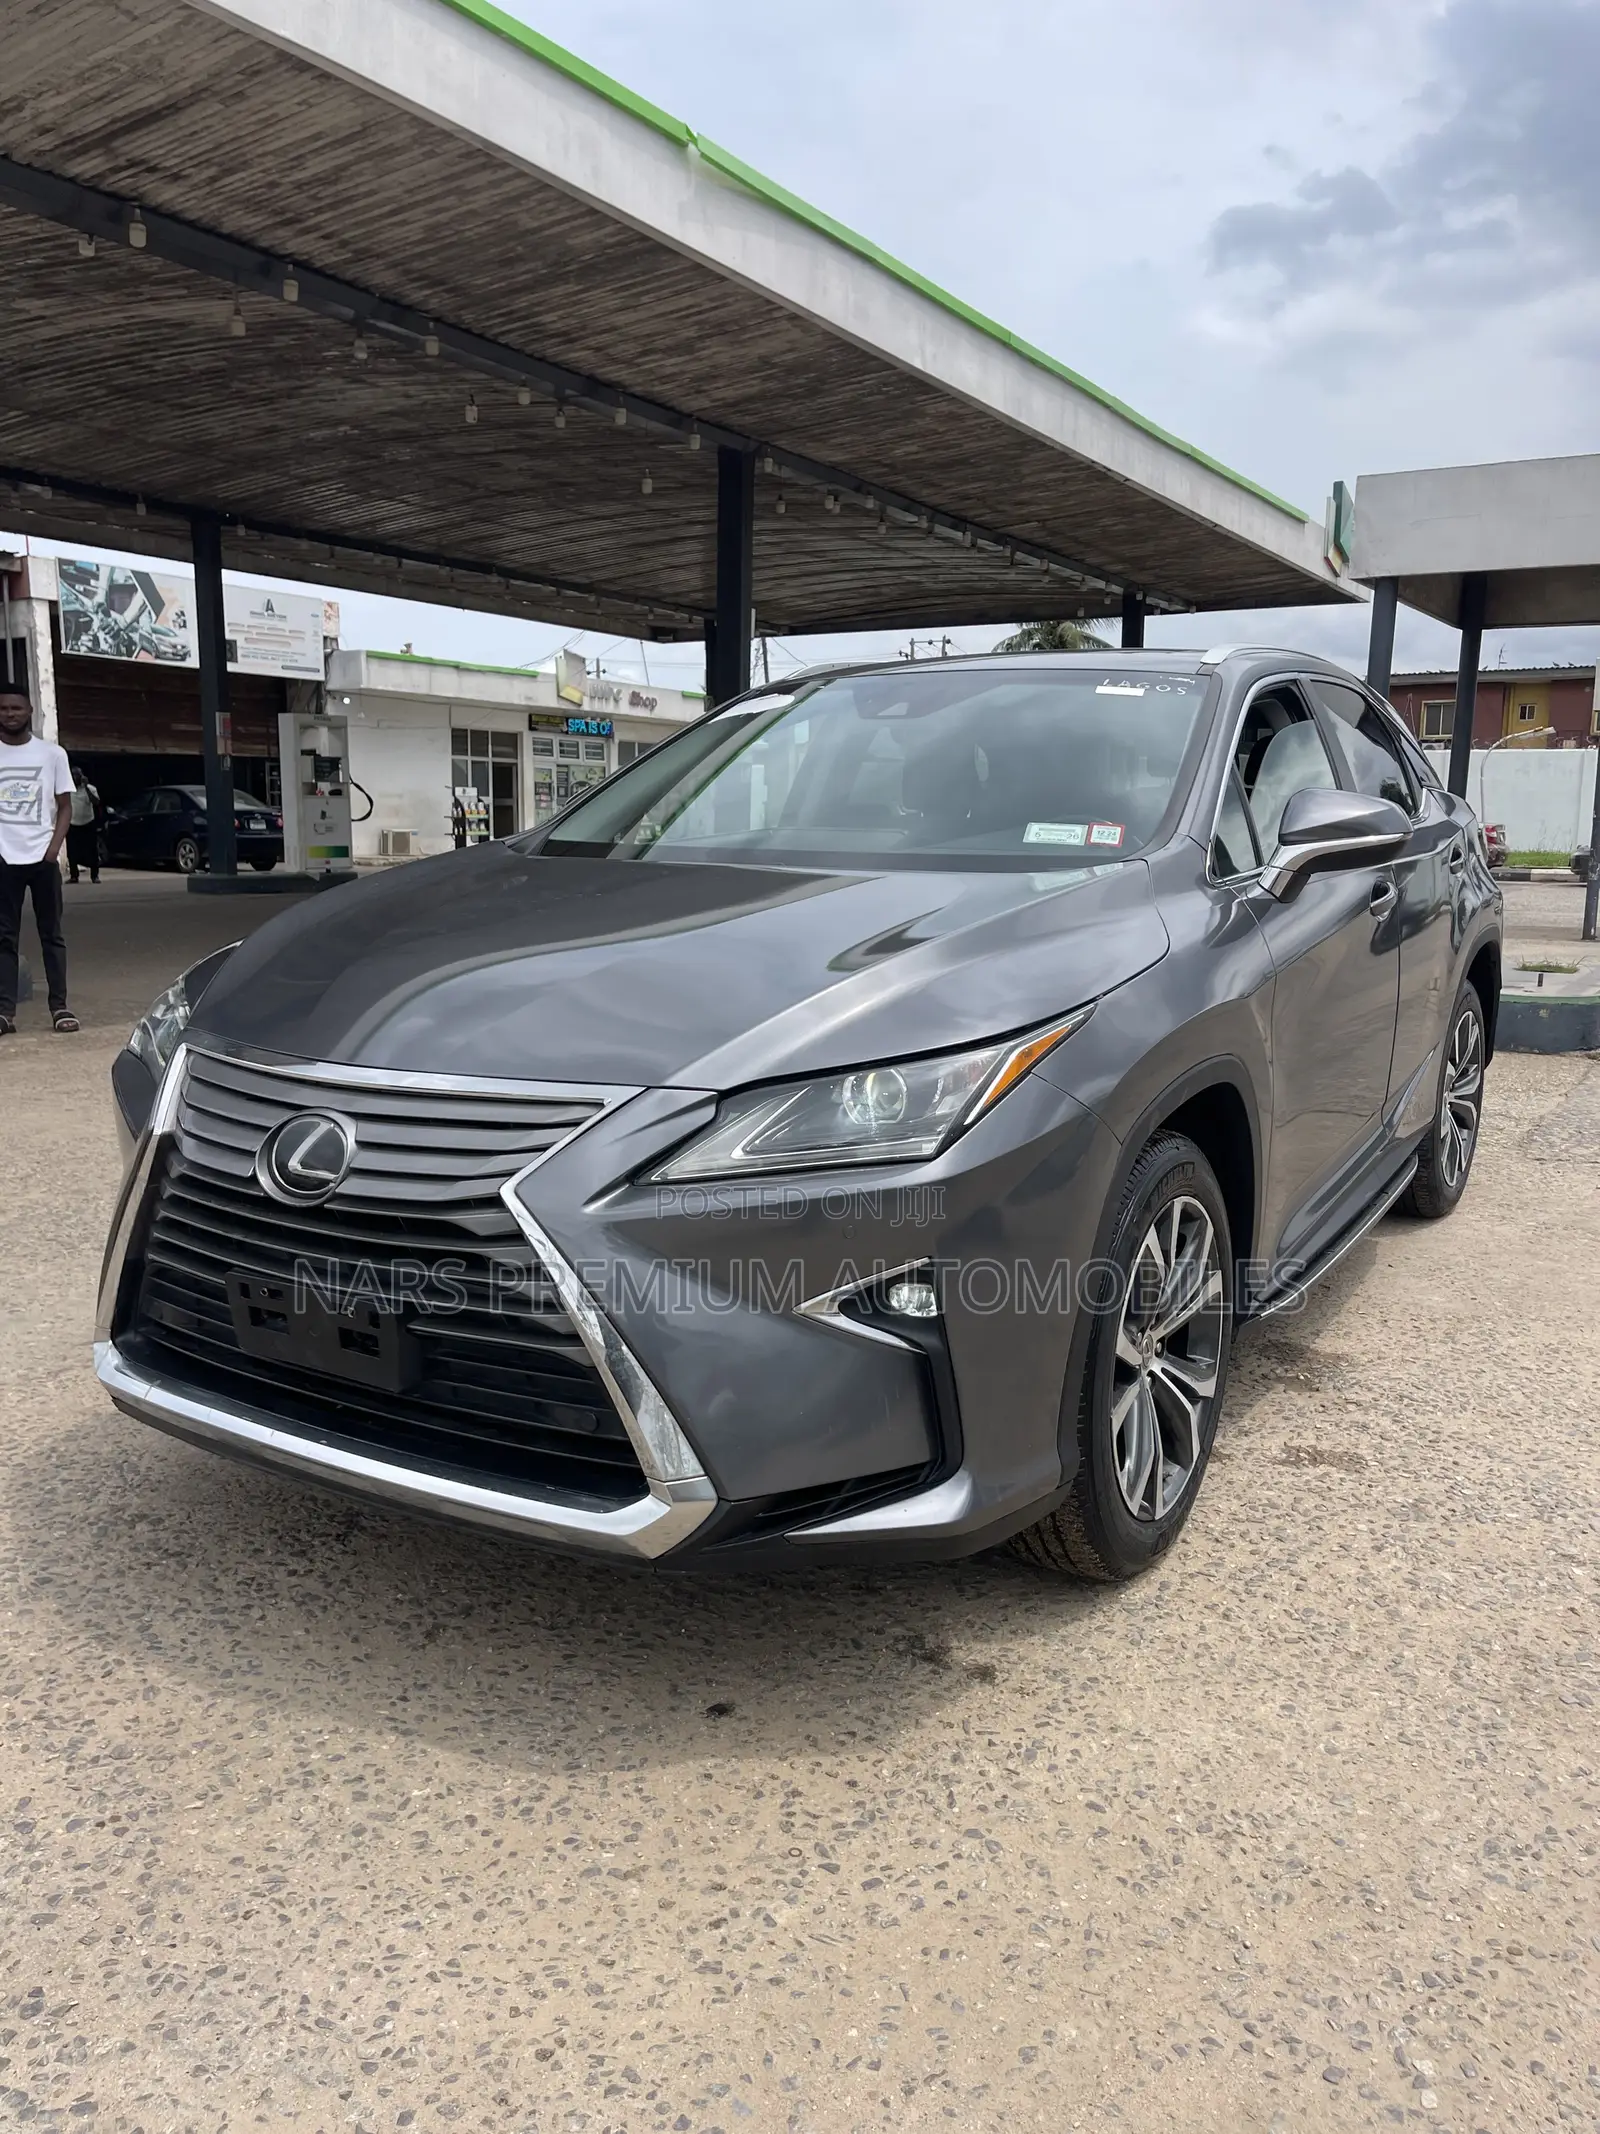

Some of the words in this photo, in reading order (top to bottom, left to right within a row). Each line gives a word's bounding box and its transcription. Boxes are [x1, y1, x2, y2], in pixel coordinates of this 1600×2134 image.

[1103, 679, 1187, 695] LAGOS
[568, 718, 586, 733] SPA
[588, 721, 598, 734] IS
